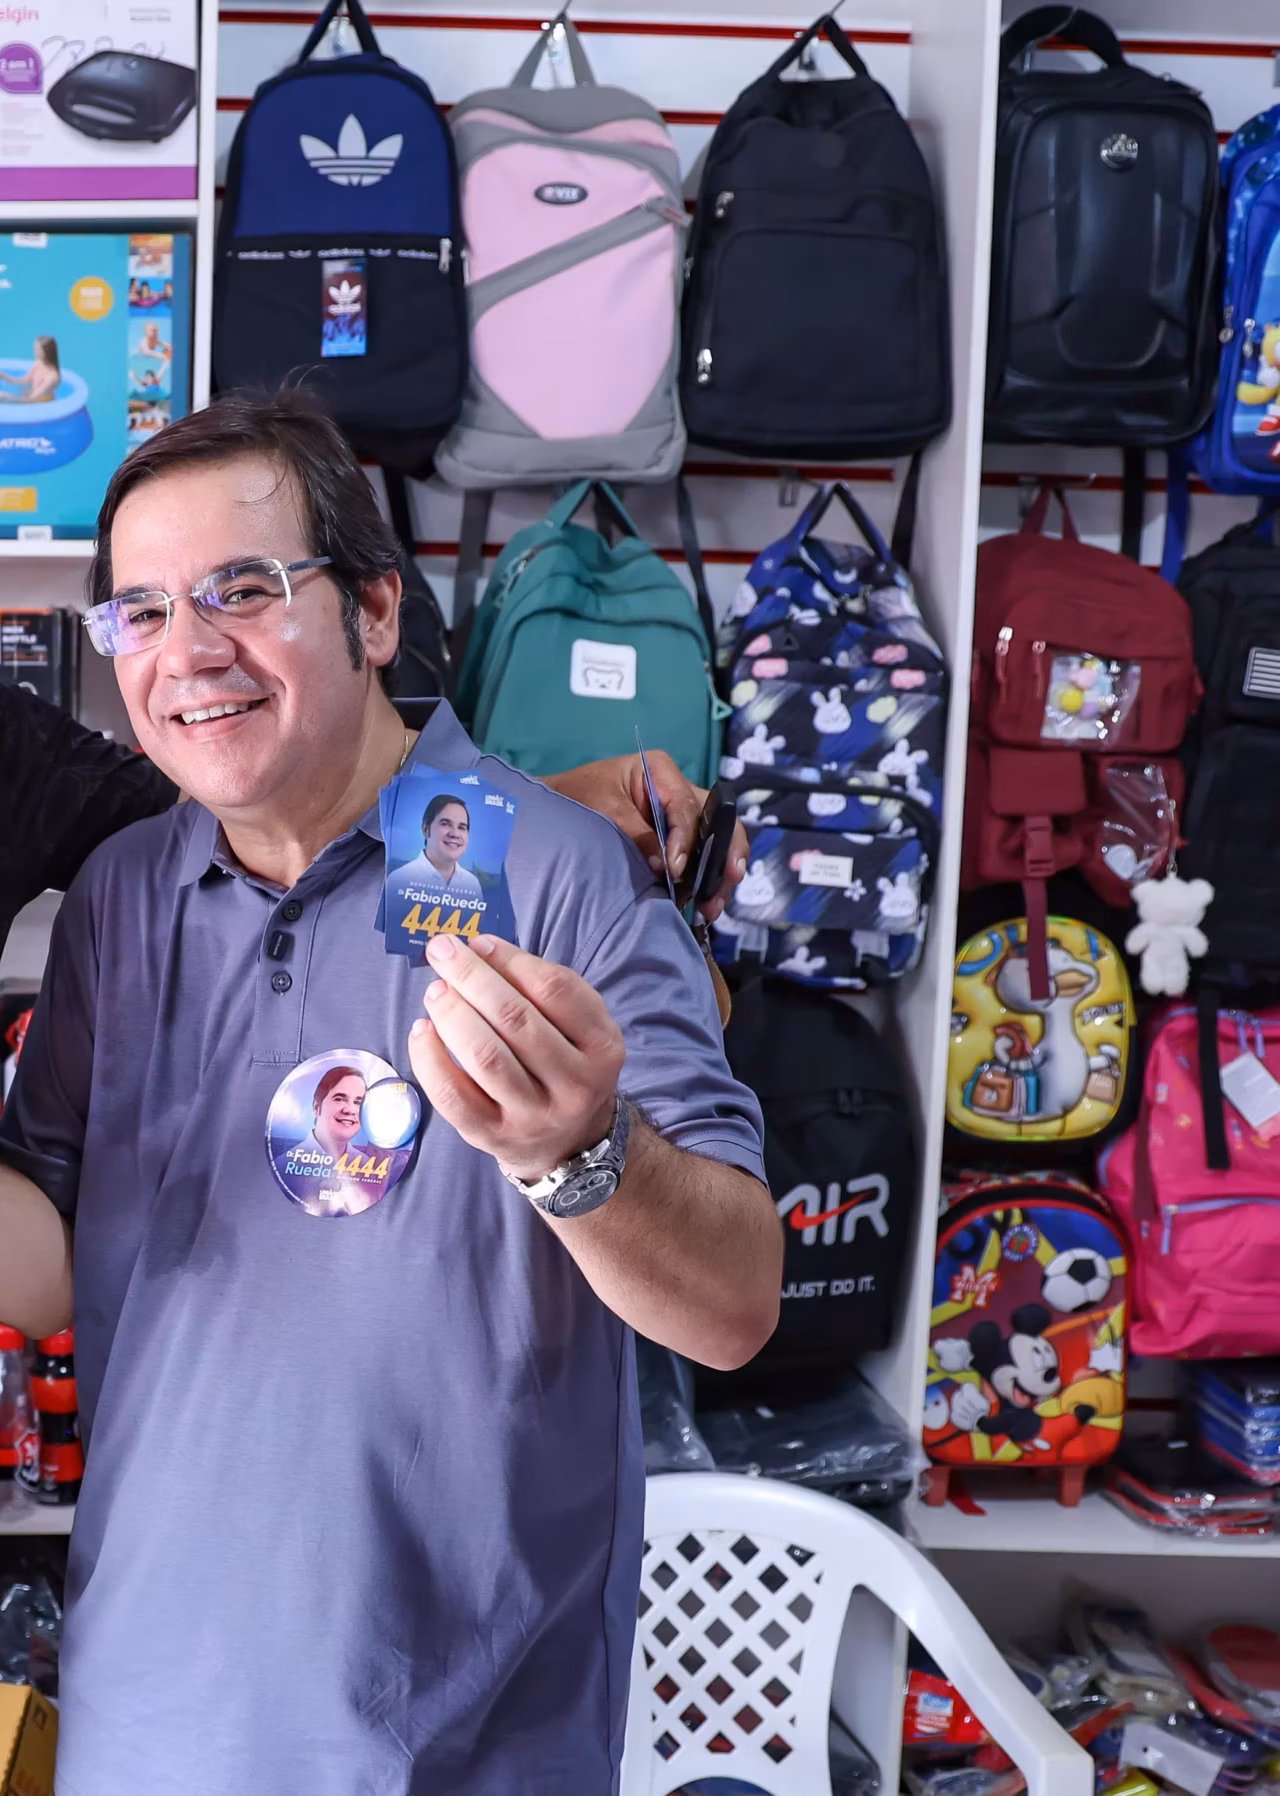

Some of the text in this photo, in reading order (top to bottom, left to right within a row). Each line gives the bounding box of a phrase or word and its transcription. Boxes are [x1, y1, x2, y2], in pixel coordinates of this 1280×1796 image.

[404, 887, 441, 905] Fabio
[441, 893, 488, 912] Rueda
[401, 903, 482, 943] 4444
[284, 1161, 332, 1178] Rueda
[293, 1148, 334, 1166] Fabio
[332, 1152, 389, 1179] 4444
[776, 1173, 890, 1246] AIR
[781, 1276, 876, 1299] JUST DO IT.
